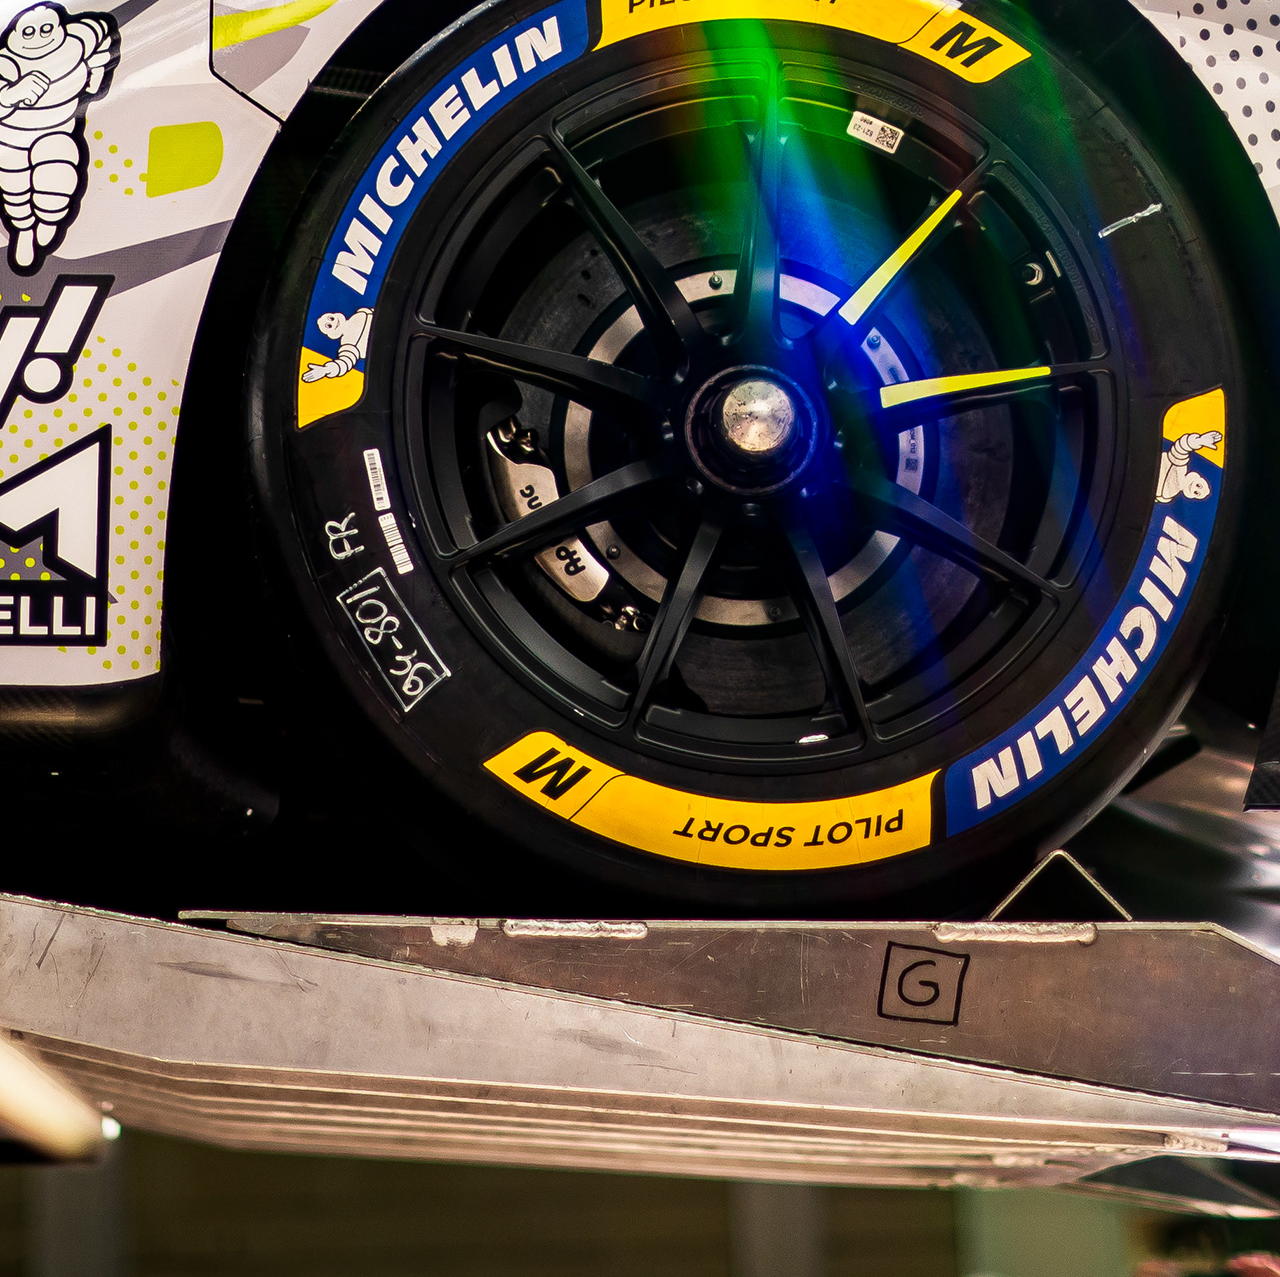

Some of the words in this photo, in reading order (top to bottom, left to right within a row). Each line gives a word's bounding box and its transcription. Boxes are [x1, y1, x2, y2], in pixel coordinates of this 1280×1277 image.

[930, 20, 1003, 68] M
[331, 16, 563, 296] MICHELIN
[325, 512, 365, 560] FR
[971, 516, 1199, 810] MICHELIN
[513, 747, 592, 801] M
[673, 816, 796, 848] SPORT
[804, 809, 904, 848] PILOT
[897, 958, 941, 1007] G
